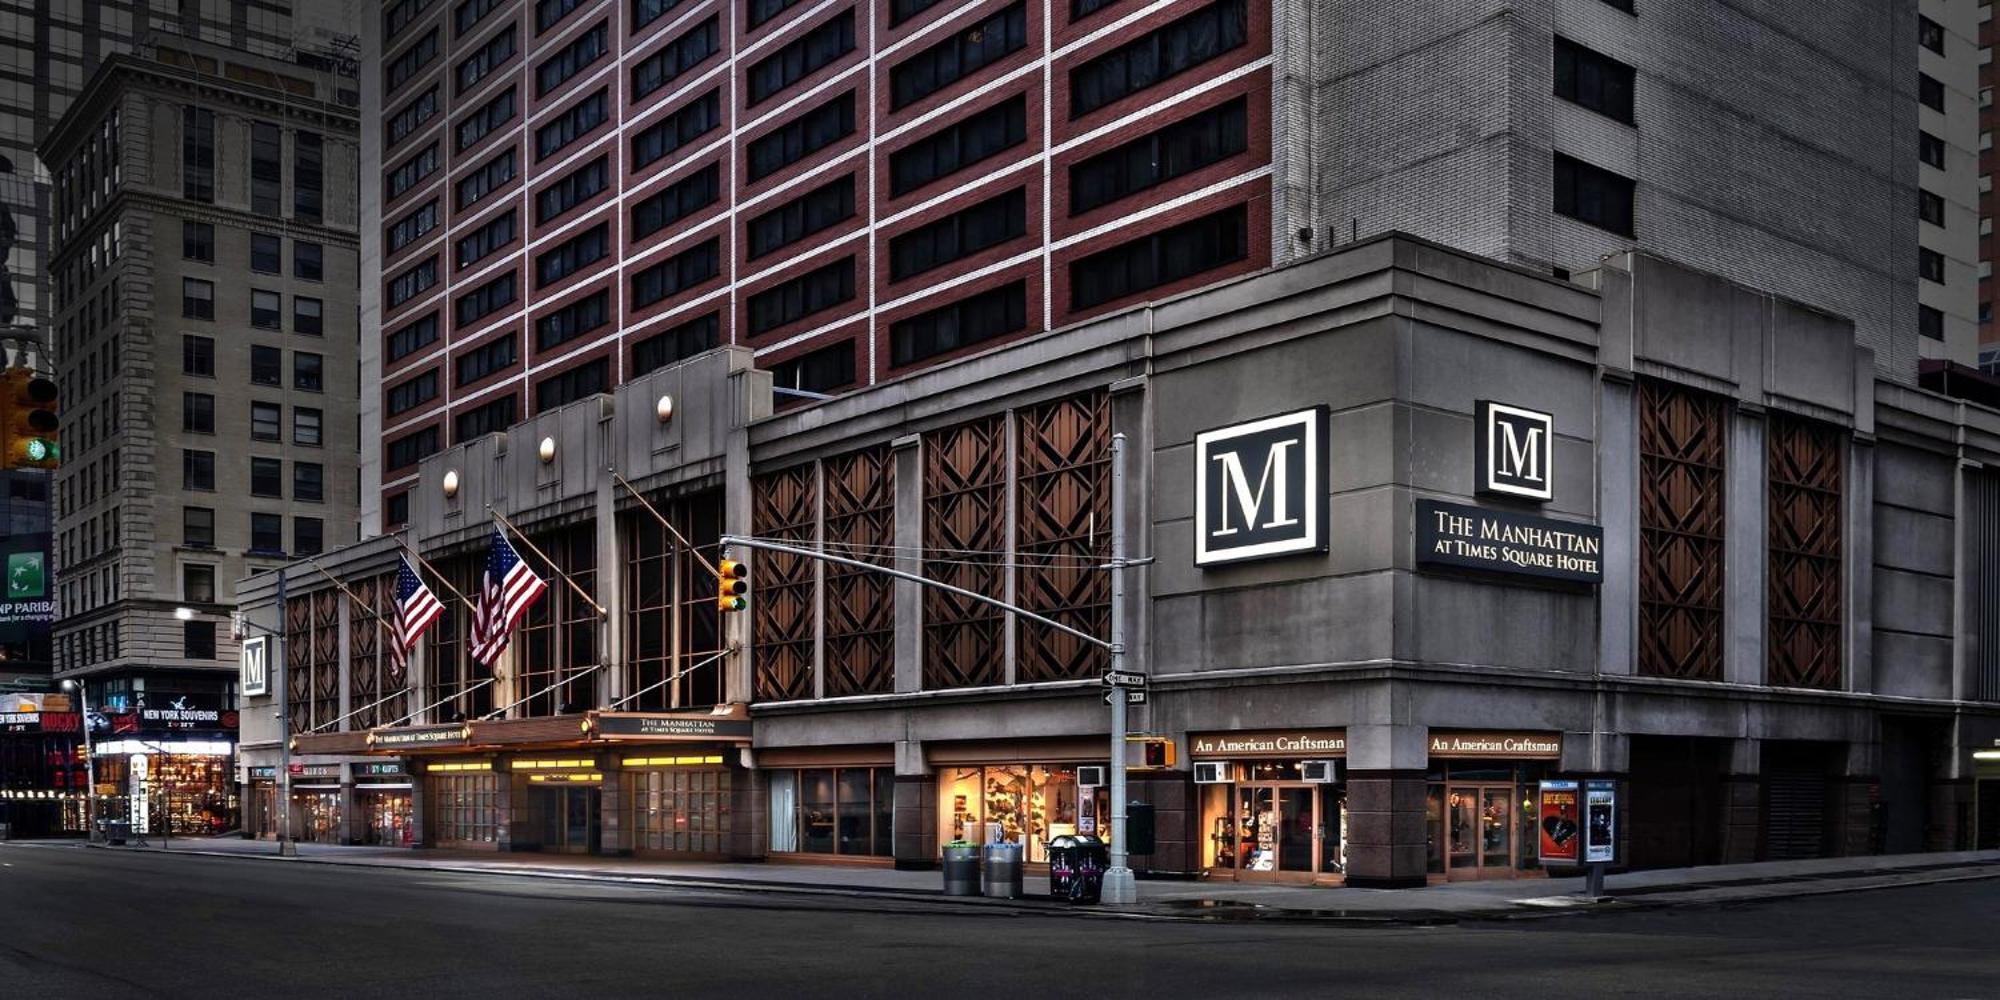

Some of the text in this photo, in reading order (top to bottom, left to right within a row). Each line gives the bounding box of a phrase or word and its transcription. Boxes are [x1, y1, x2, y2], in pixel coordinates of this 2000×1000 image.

[1496, 420, 1543, 483] M
[1212, 438, 1299, 537] M
[1434, 510, 1600, 555] THE MANHATTAN
[1434, 539, 1600, 574] AT TIMES SQUARE HOTEL
[0, 603, 13, 614] NP
[245, 647, 263, 685] M
[143, 709, 218, 721] NEW YORK SOUVENIRS
[660, 720, 715, 729] MANHATTAN
[1195, 735, 1345, 752] An American Craftsman
[1432, 737, 1559, 752] An American Craftsman
